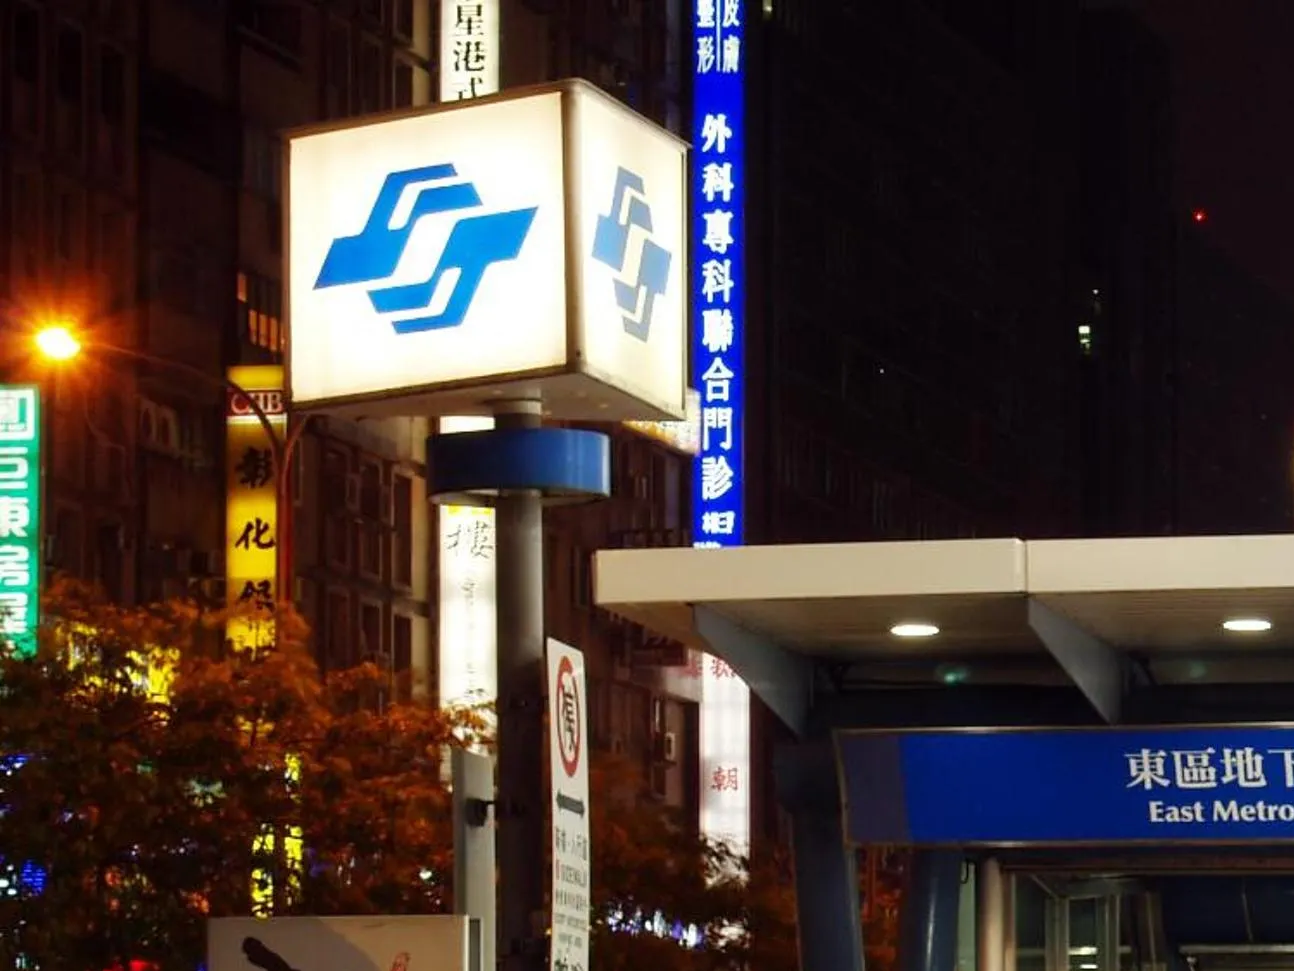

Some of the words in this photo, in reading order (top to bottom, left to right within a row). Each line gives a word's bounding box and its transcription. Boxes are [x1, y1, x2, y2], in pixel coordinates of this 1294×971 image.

[702, 113, 735, 501] 外科專科聯合門診
[1149, 800, 1205, 823] East
